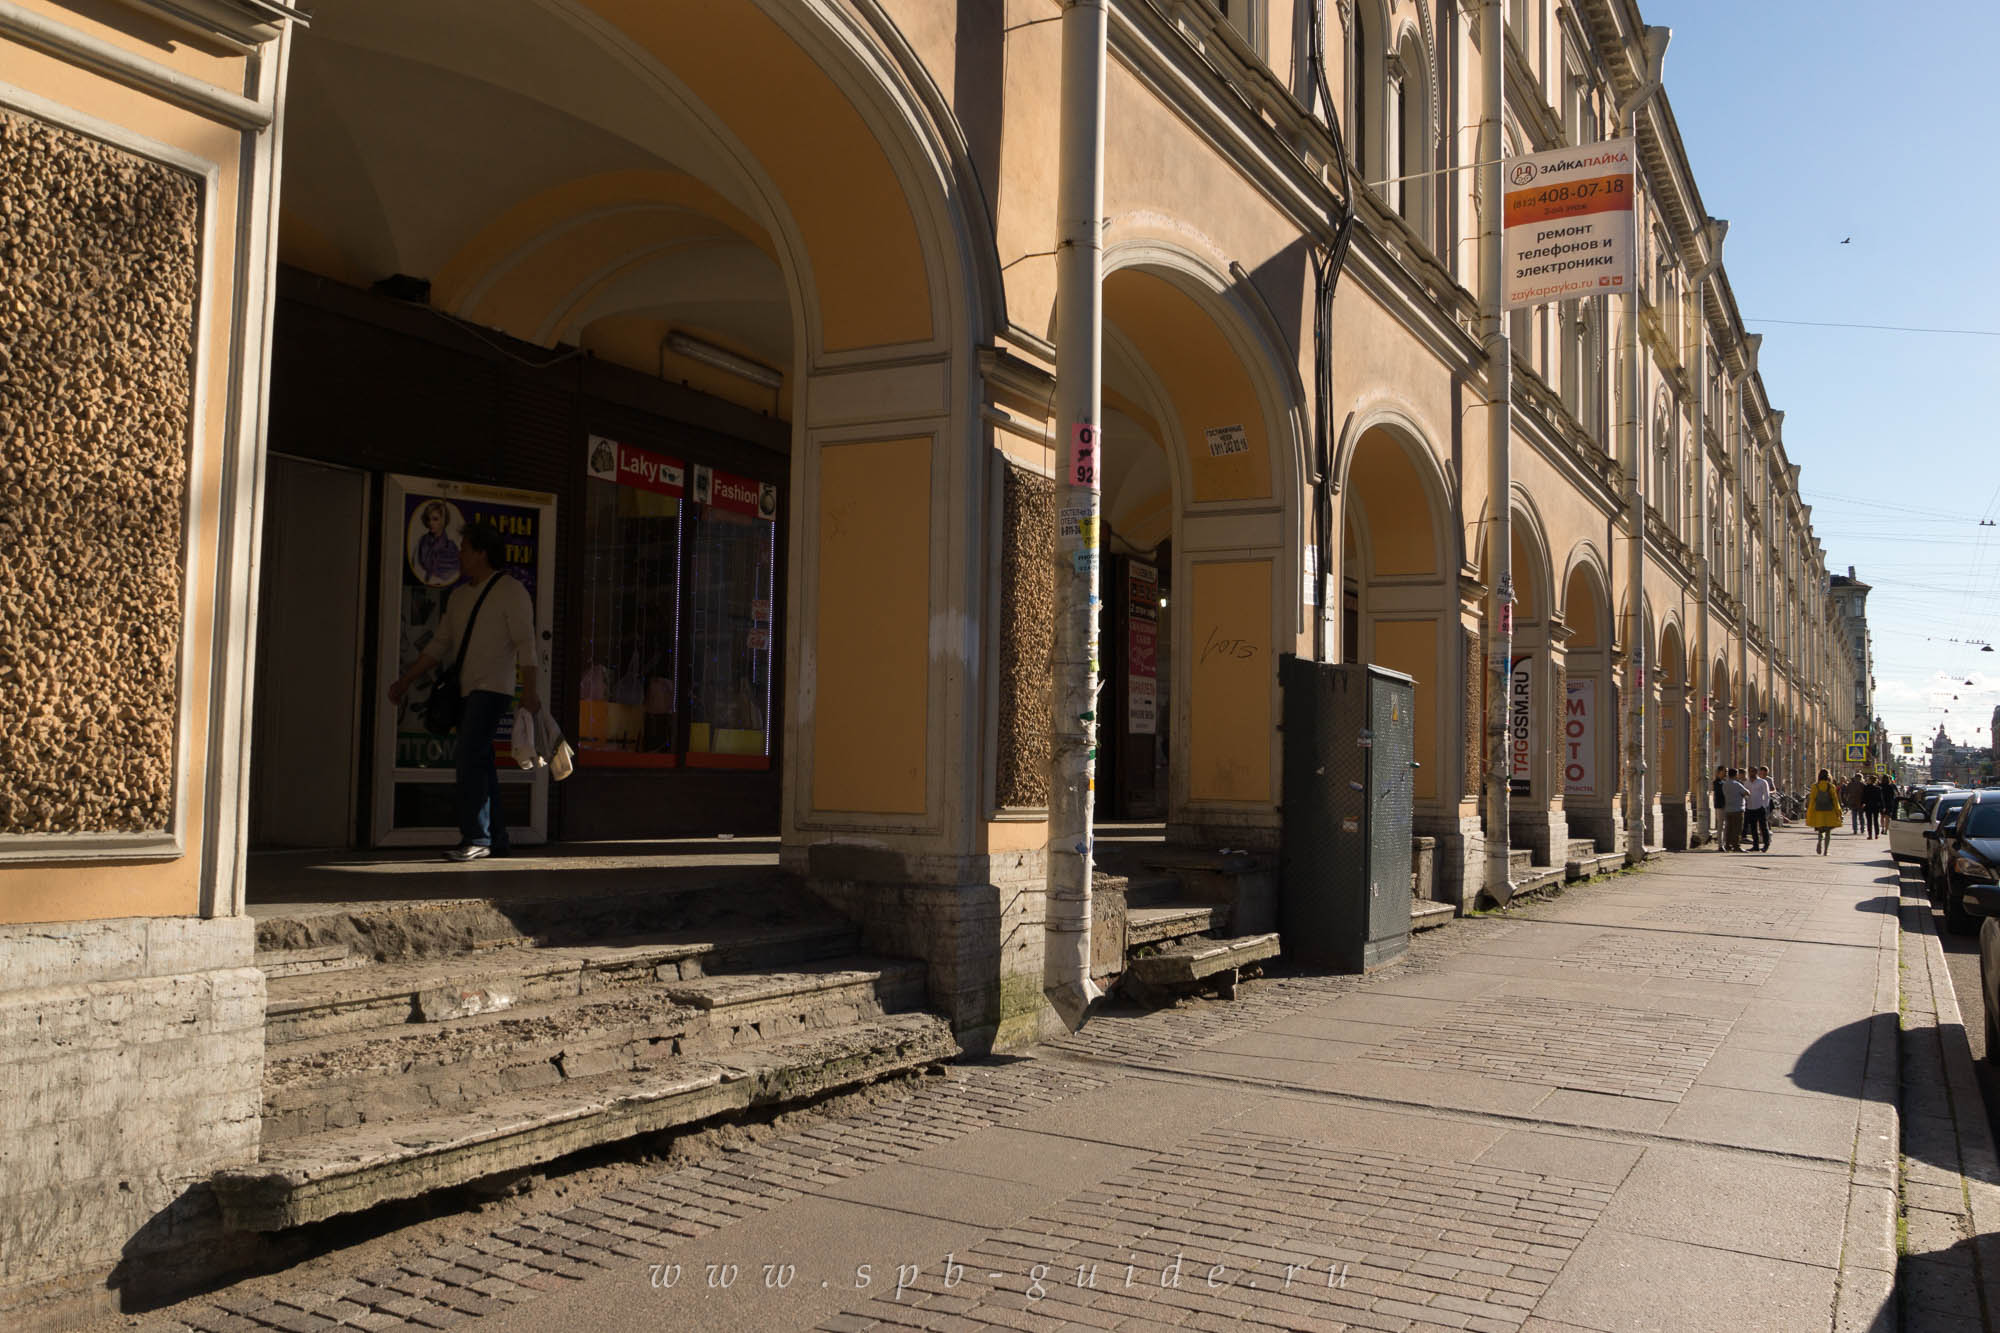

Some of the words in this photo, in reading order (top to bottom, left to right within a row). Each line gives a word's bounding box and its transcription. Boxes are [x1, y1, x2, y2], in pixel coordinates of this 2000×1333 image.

[1540, 153, 1629, 174] ЗАЙКАПАЙКА
[1538, 178, 1625, 203] 408-07-18
[1537, 224, 1593, 243] ремонт
[1517, 240, 1599, 261] телефонов
[1602, 238, 1613, 248] и
[1516, 256, 1613, 279] электроники
[1511, 280, 1594, 301] zaykapayka.ru
[620, 448, 659, 483] Laky
[713, 479, 758, 505] Fashion
[1513, 671, 1529, 776] TAGGSM.RU
